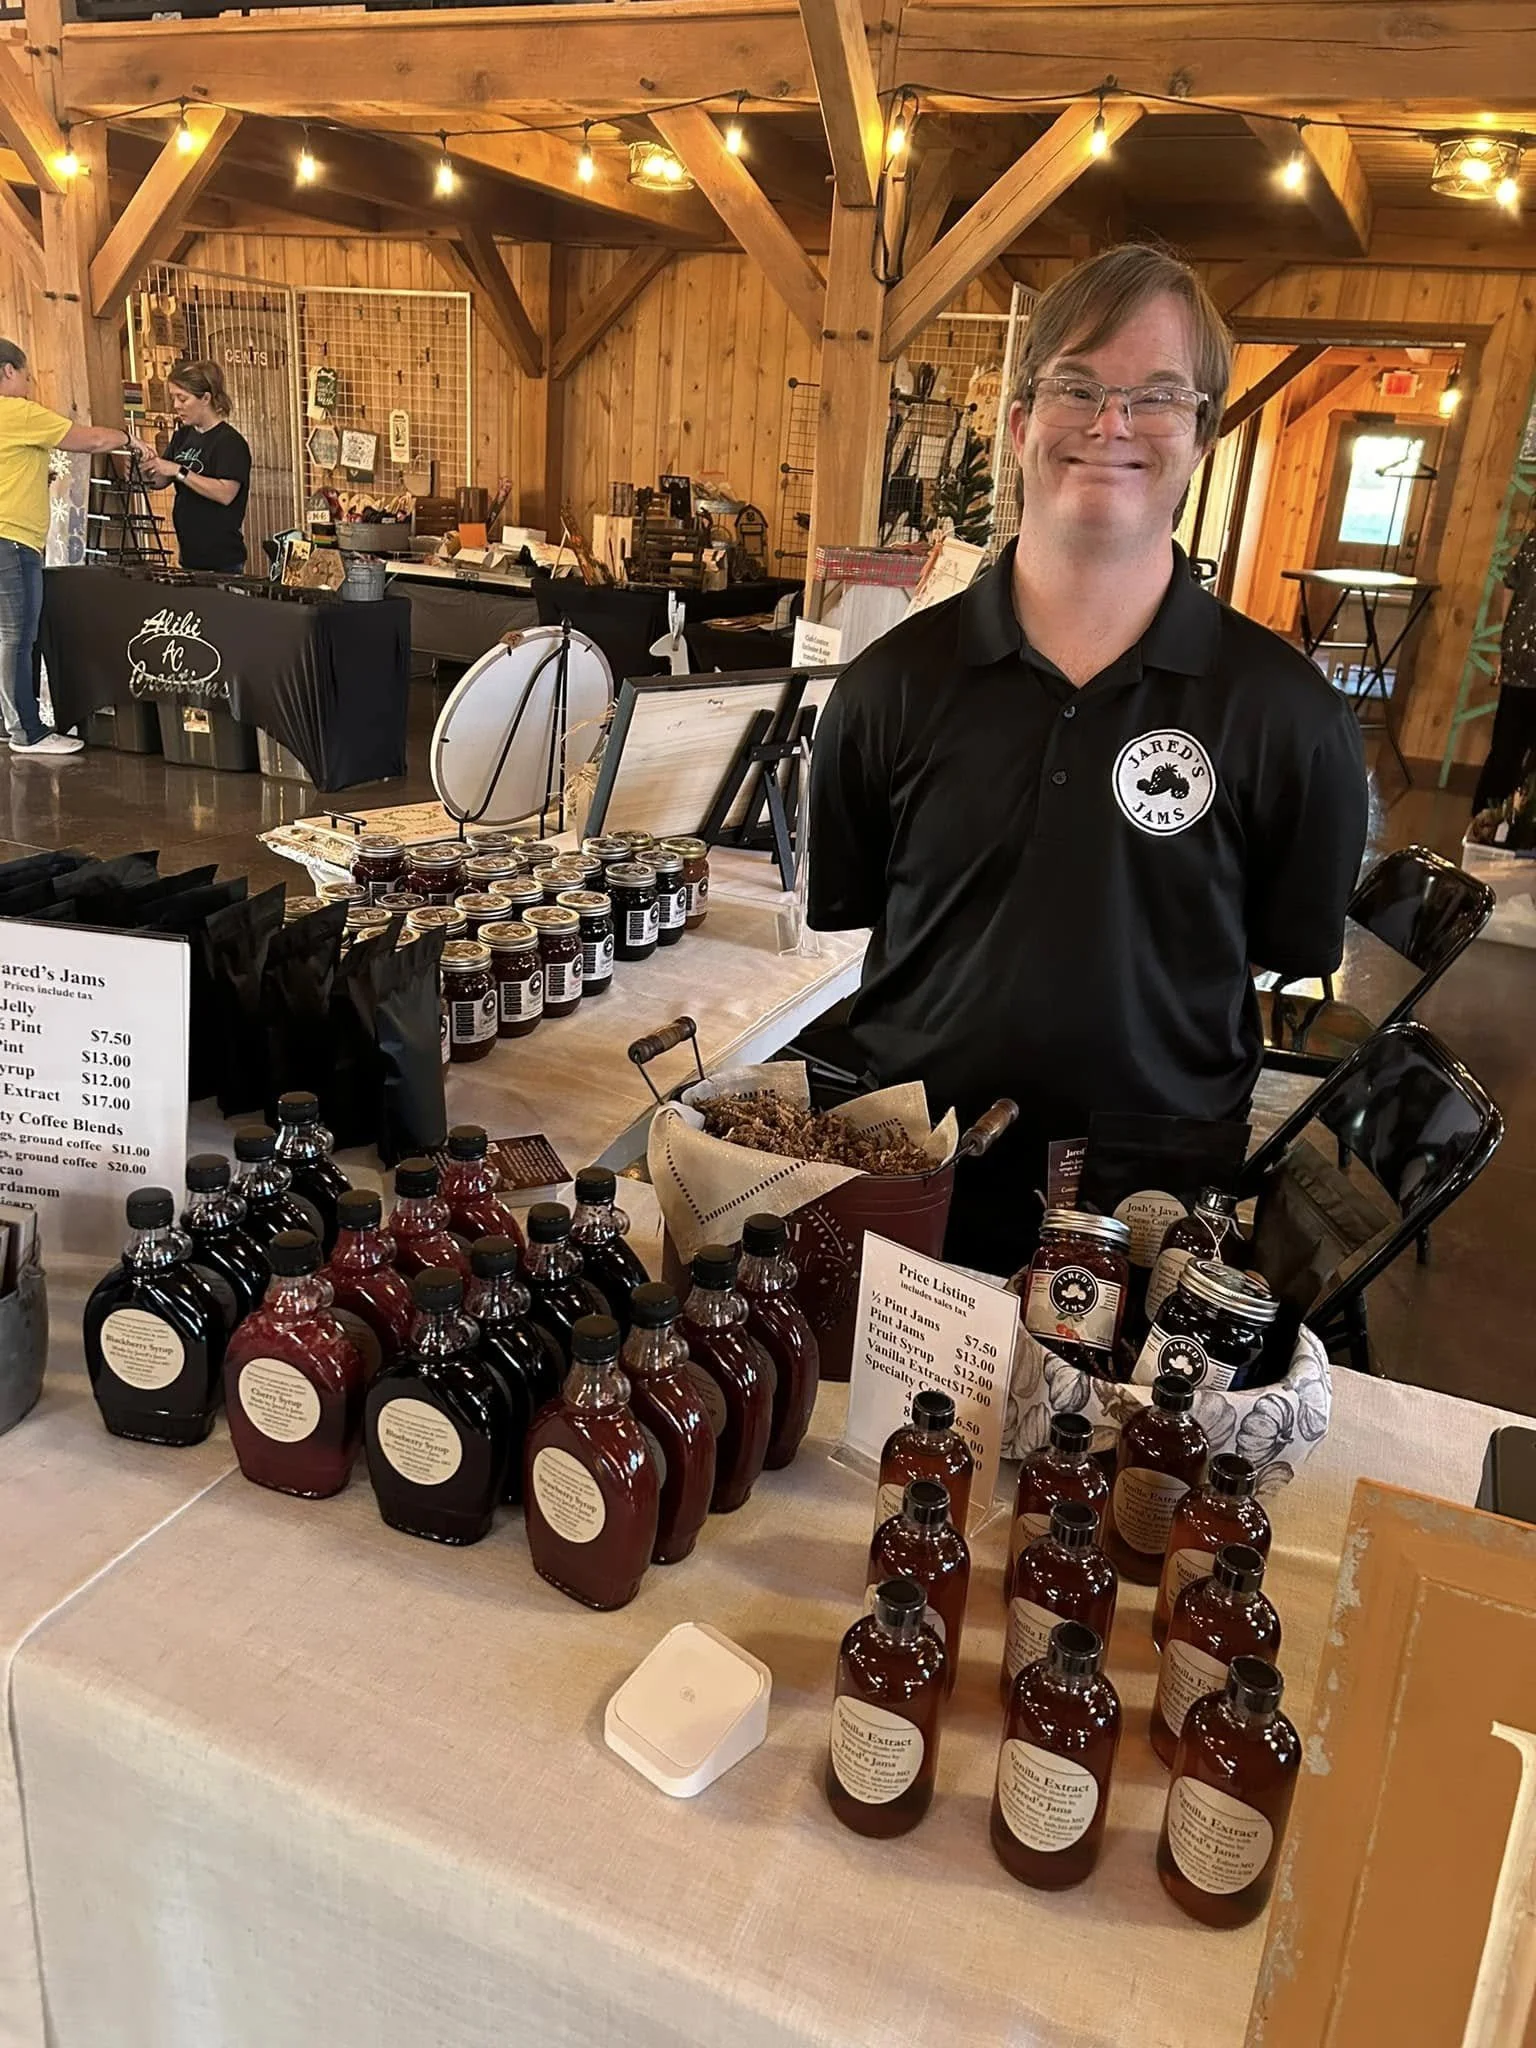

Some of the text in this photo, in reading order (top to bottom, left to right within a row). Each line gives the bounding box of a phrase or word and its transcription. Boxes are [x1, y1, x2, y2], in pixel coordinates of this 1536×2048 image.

[141, 608, 201, 637] Alibi
[162, 639, 184, 672] AC
[129, 660, 231, 698] Creations
[1128, 740, 1205, 778] JARED'S
[1132, 801, 1185, 824] JAMS
[1, 964, 106, 987] ared's Jams
[4, 980, 93, 1000] Prices include tax
[11, 1018, 131, 1046] Pint $7.50
[0, 1039, 131, 1068] int $13.00
[0, 1063, 131, 1089] yrup $12.00
[4, 1082, 131, 1111] Extract $17.00
[19, 1111, 68, 1129] Coffee
[73, 1118, 124, 1136] Blends
[19, 1133, 63, 1147] ground
[66, 1139, 102, 1152] coffee
[112, 1143, 150, 1157] $11.00
[0, 1166, 23, 1177] cao
[15, 1151, 59, 1165] ground
[62, 1156, 98, 1169] coffee
[107, 1160, 147, 1175] $20.00
[0, 1180, 60, 1198] rdamom
[1126, 1202, 1179, 1217] Josh's Java
[899, 1262, 976, 1310] Price Listing
[1057, 1272, 1093, 1292] JARED'S
[900, 1280, 967, 1317] includes sales tax
[870, 1306, 995, 1374] Pint Jams $13.00
[884, 1296, 907, 1316] Pint
[910, 1309, 940, 1331] Jams
[964, 1334, 997, 1358] $7.50
[867, 1337, 905, 1365] Vanilla
[868, 1322, 897, 1345] Fruit
[900, 1337, 935, 1363] Syrup
[953, 1364, 993, 1391] $12.00
[865, 1353, 916, 1387] Specialty
[956, 1416, 980, 1436] 6.50
[1176, 1561, 1199, 1579] Vanill
[868, 1732, 912, 1747] Extract
[840, 1740, 896, 1768] Jared's Jams
[1010, 1751, 1090, 1793] Vanilla Extract
[1012, 1782, 1072, 1814] Jared's Jams
[1179, 1787, 1259, 1838] Vanilla Extract
[1180, 1820, 1241, 1859] Jared's Jams
